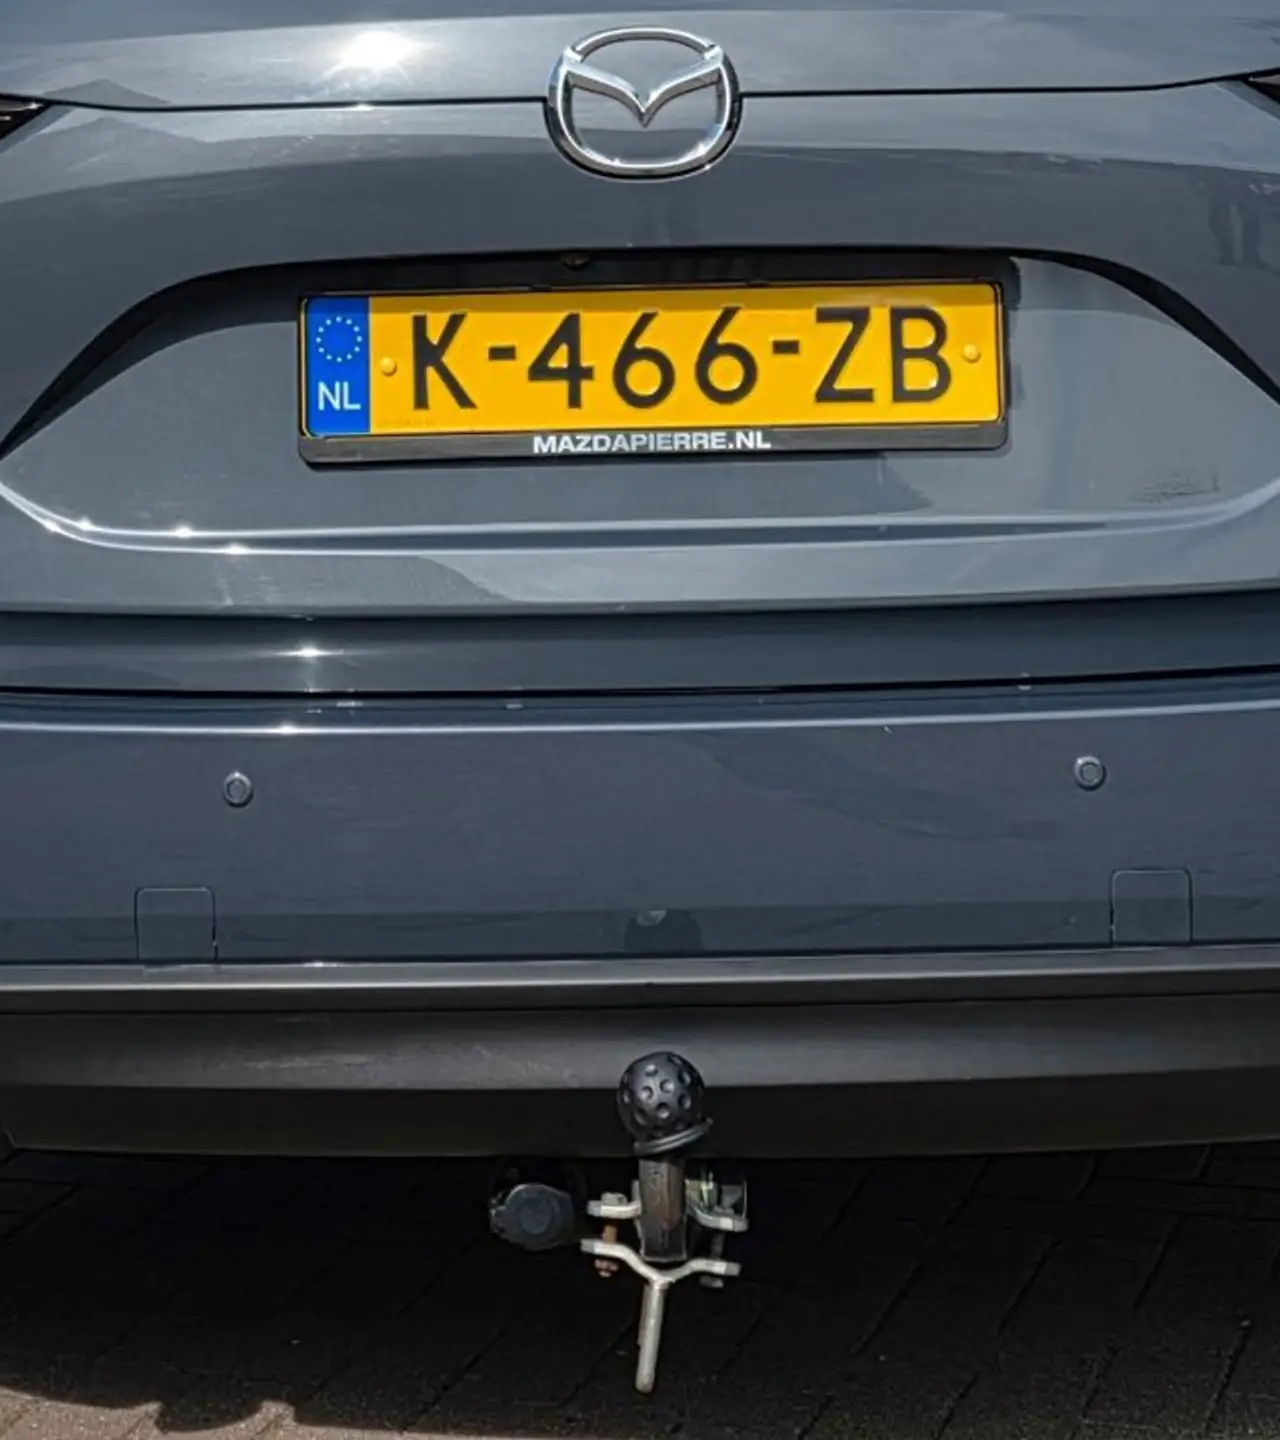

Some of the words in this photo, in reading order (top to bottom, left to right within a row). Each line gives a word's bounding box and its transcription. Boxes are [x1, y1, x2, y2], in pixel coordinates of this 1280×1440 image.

[411, 305, 952, 411] K-466-ZB
[317, 381, 361, 411] NL
[533, 430, 771, 454] MAZDAPIERRE.NL
